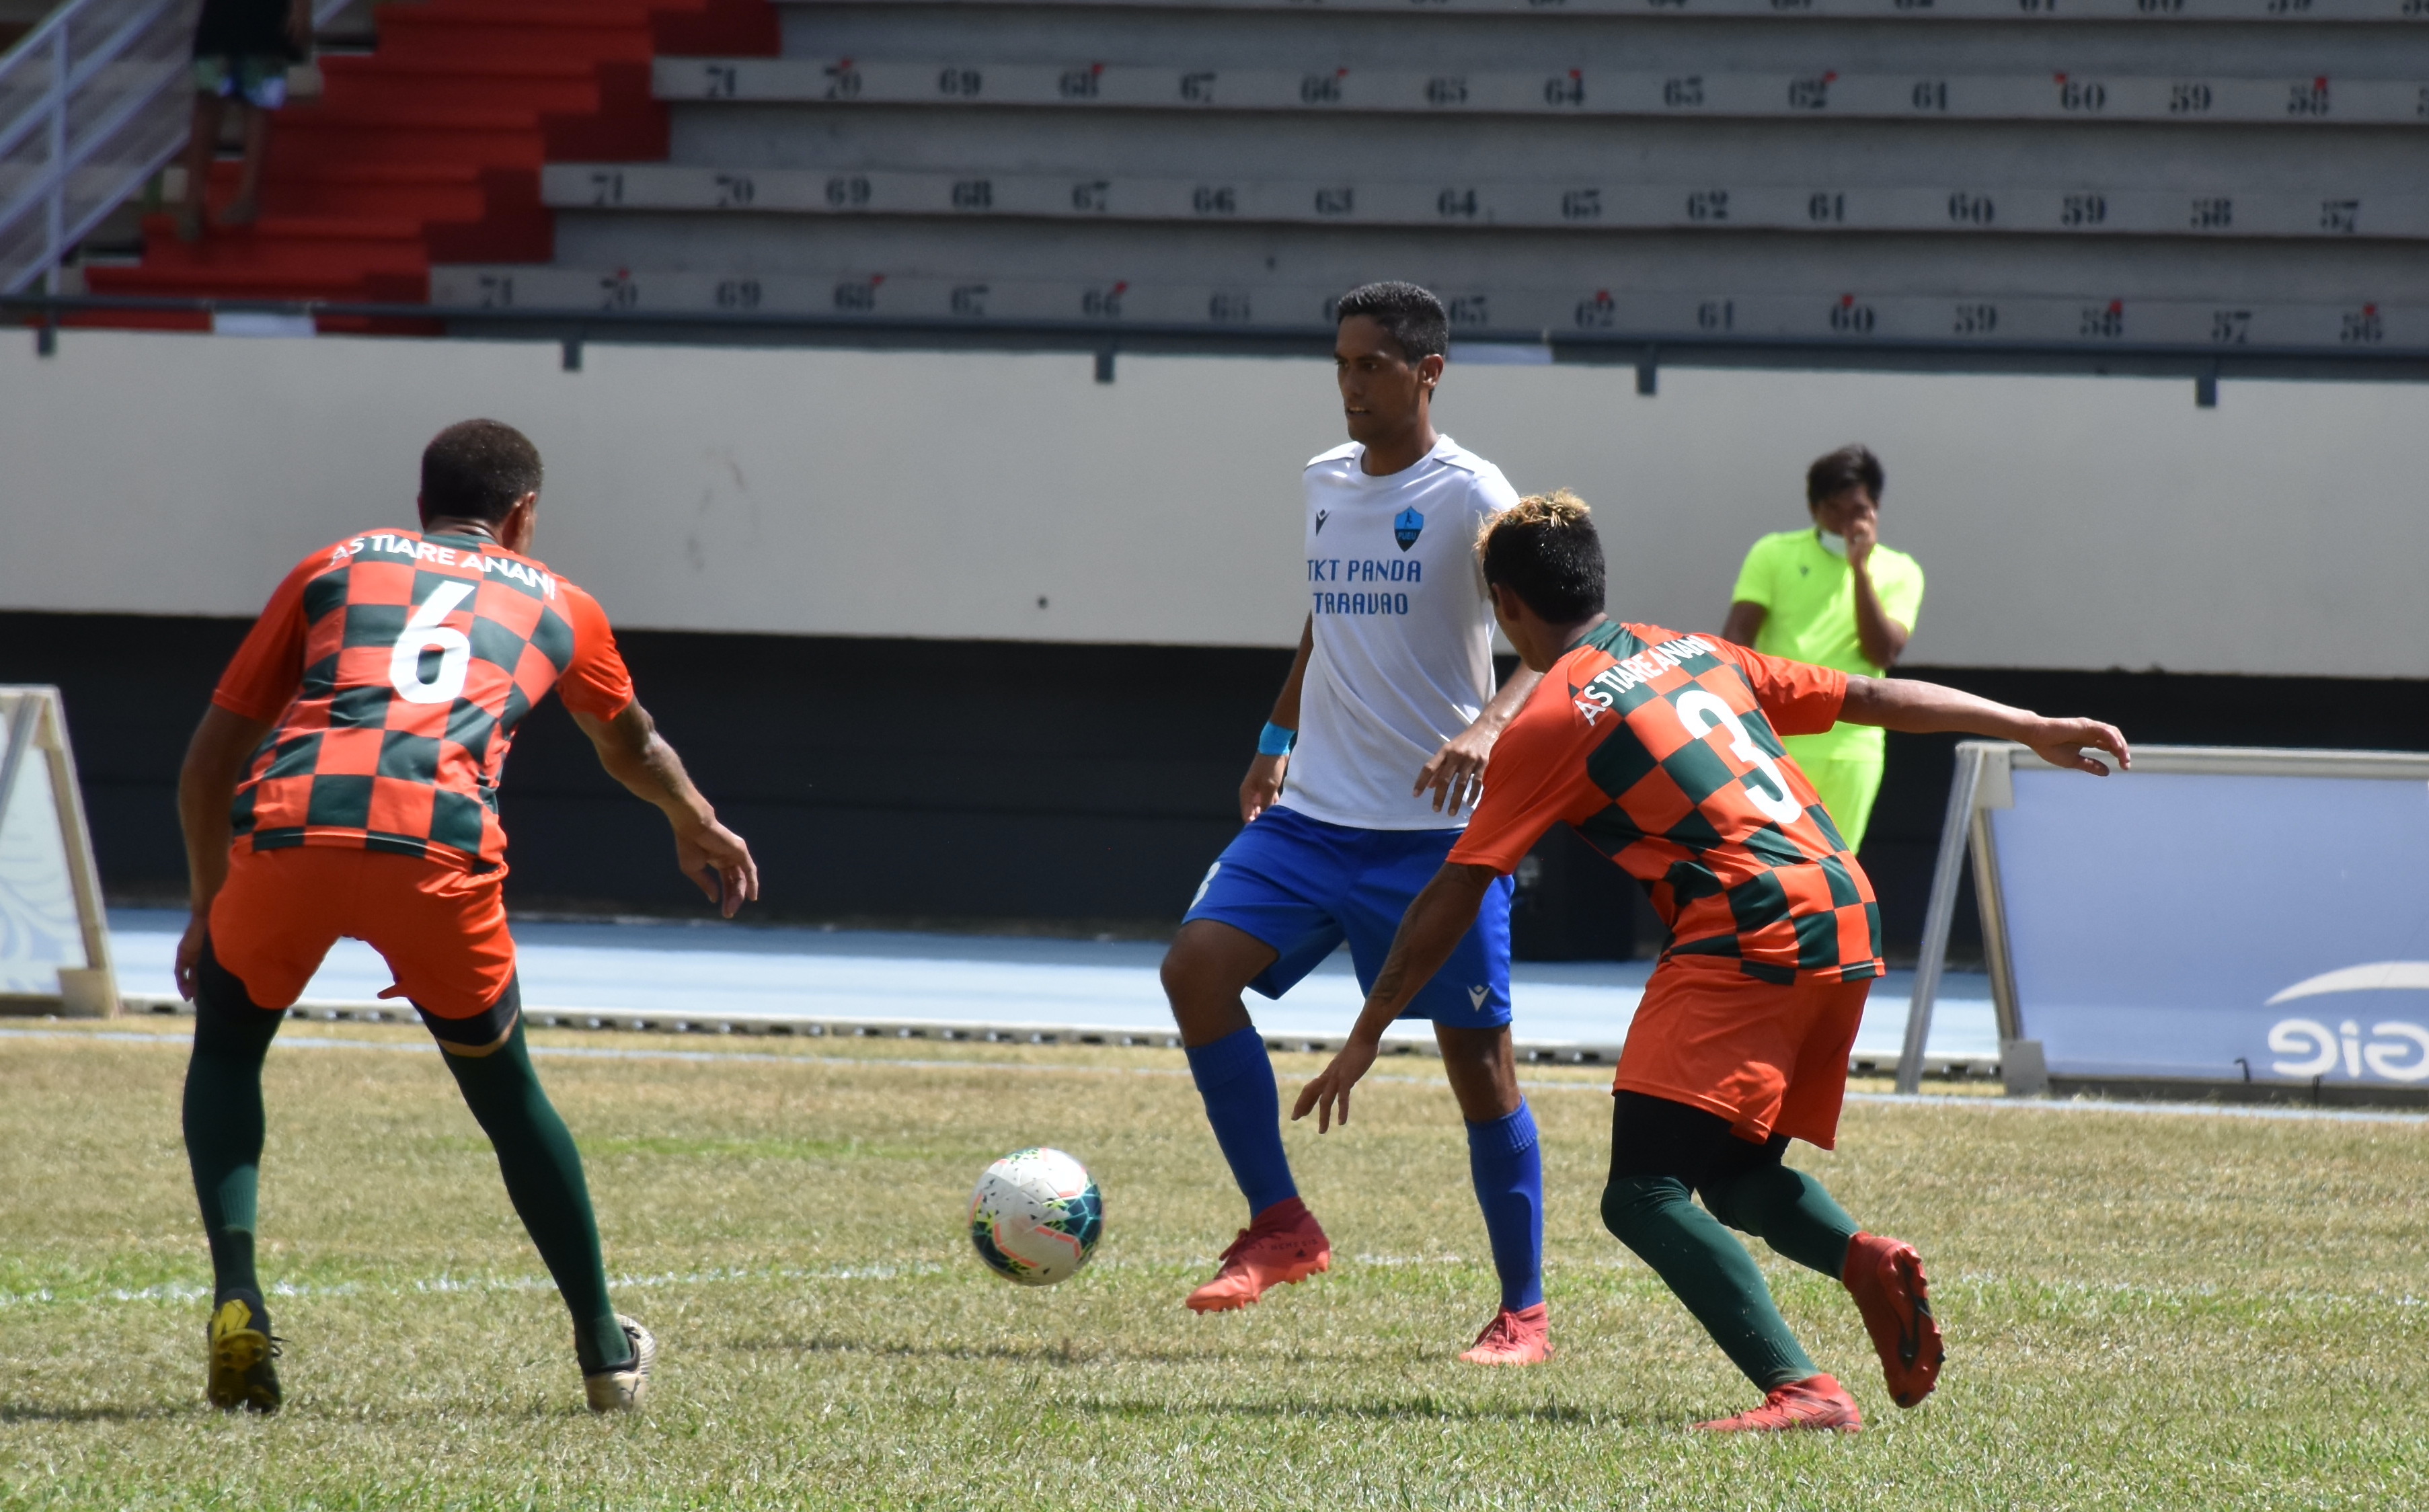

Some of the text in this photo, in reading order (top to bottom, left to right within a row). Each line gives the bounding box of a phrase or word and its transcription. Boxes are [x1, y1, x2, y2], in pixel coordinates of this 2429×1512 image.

[706, 67, 737, 97] 71
[824, 67, 862, 99] 70
[939, 69, 982, 96] 69
[1180, 73, 1217, 104] 67
[1301, 75, 1342, 103] 66
[1544, 77, 1585, 106] 64
[1789, 78, 1828, 110] 62
[1912, 81, 1947, 112] 61
[2060, 82, 2106, 112] 60
[2169, 85, 2212, 113] 59
[2287, 84, 2329, 116] 58
[592, 173, 624, 205] 71
[714, 174, 755, 206] 70
[825, 177, 872, 206] 69
[952, 180, 993, 209] 68
[1071, 180, 1110, 213] 67
[1193, 188, 1235, 213] 66
[1437, 189, 1477, 218] 64
[1687, 191, 1728, 220] 62
[1808, 192, 1844, 222] 61
[1948, 192, 1995, 225] 60
[2061, 195, 2106, 226] 59
[2190, 198, 2232, 229] 58
[479, 276, 514, 309] 71
[601, 278, 638, 310] 70
[716, 280, 761, 309] 69
[1082, 290, 1122, 318] 66
[1575, 299, 1615, 328] 62
[1697, 301, 1734, 330] 61
[1830, 303, 1875, 333] 60
[1954, 305, 1998, 333] 59
[2080, 309, 2123, 336] 58
[330, 534, 556, 600] AS TIARE ANANI
[1307, 559, 1422, 582] TKT PANDA
[1313, 592, 1409, 614] TARAVAO
[389, 580, 475, 704] 6
[1574, 635, 1717, 726] AS TIARE ANANI
[1676, 690, 1802, 824] 3
